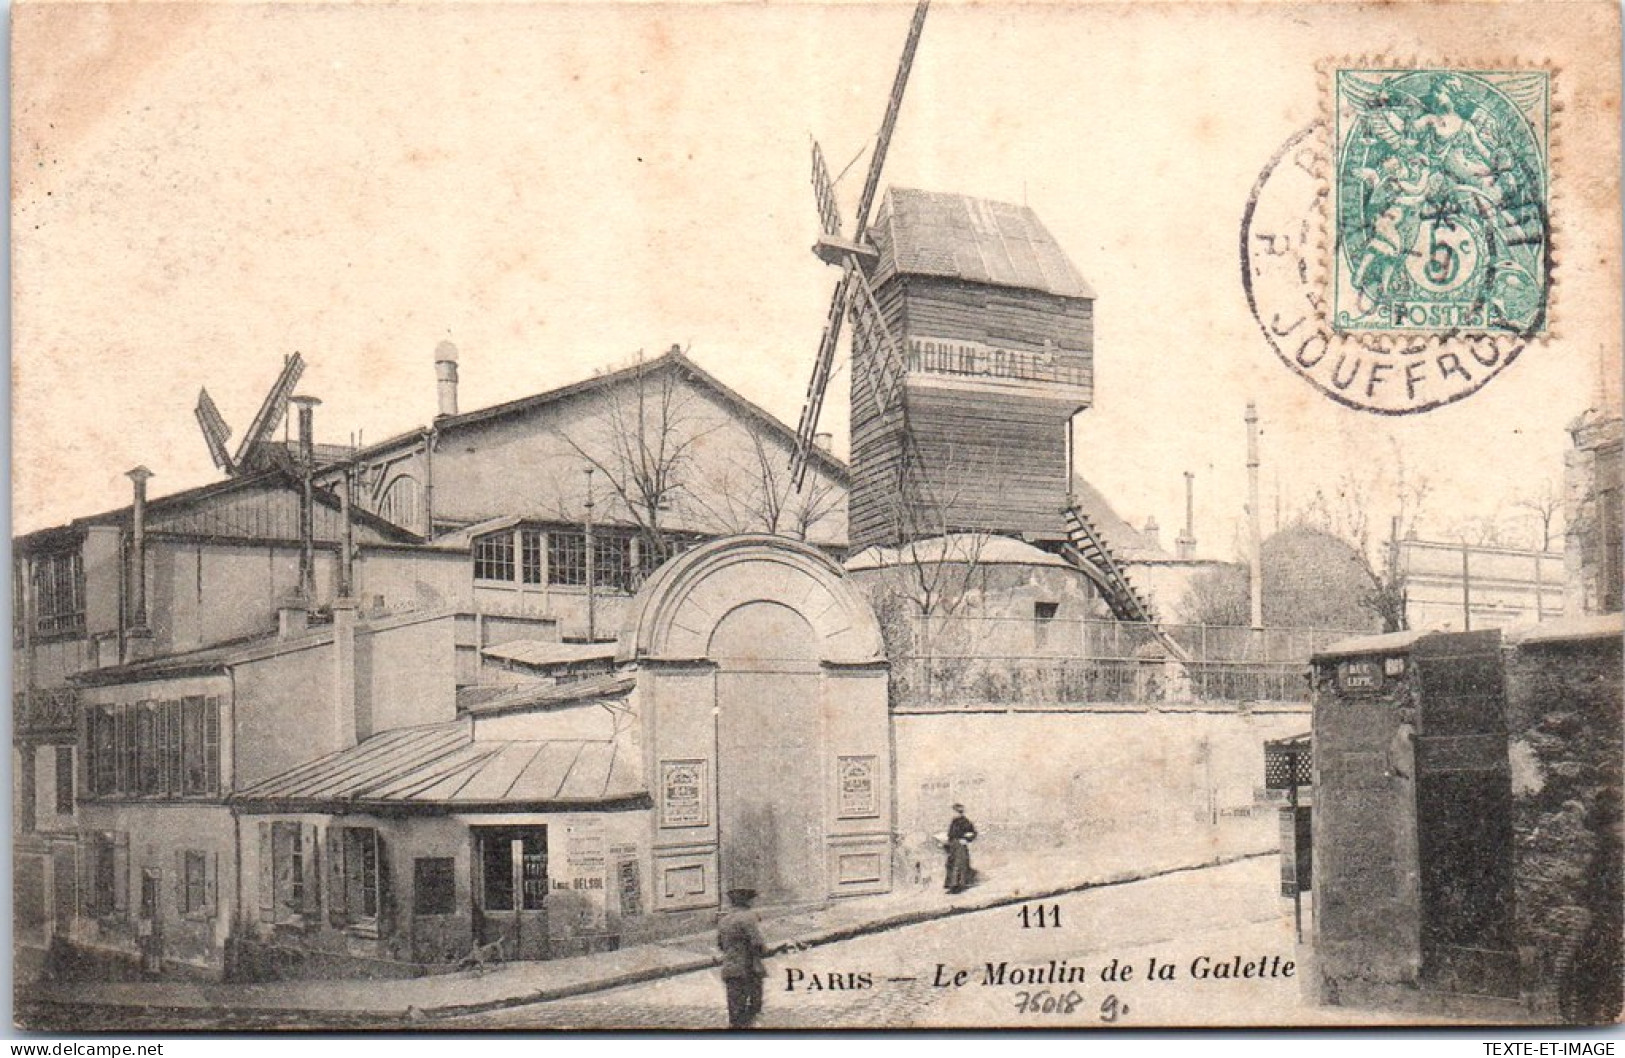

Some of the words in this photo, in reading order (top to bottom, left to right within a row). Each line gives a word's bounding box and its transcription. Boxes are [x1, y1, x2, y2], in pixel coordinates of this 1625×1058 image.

[1394, 304, 1483, 326] POSTES
[907, 338, 978, 376] MOULIN
[1017, 905, 1062, 928] 111
[932, 963, 968, 987] Le
[981, 960, 1086, 986] Moulin
[1100, 959, 1134, 982] de
[1147, 957, 1176, 981] la
[1190, 955, 1296, 980] Galette
